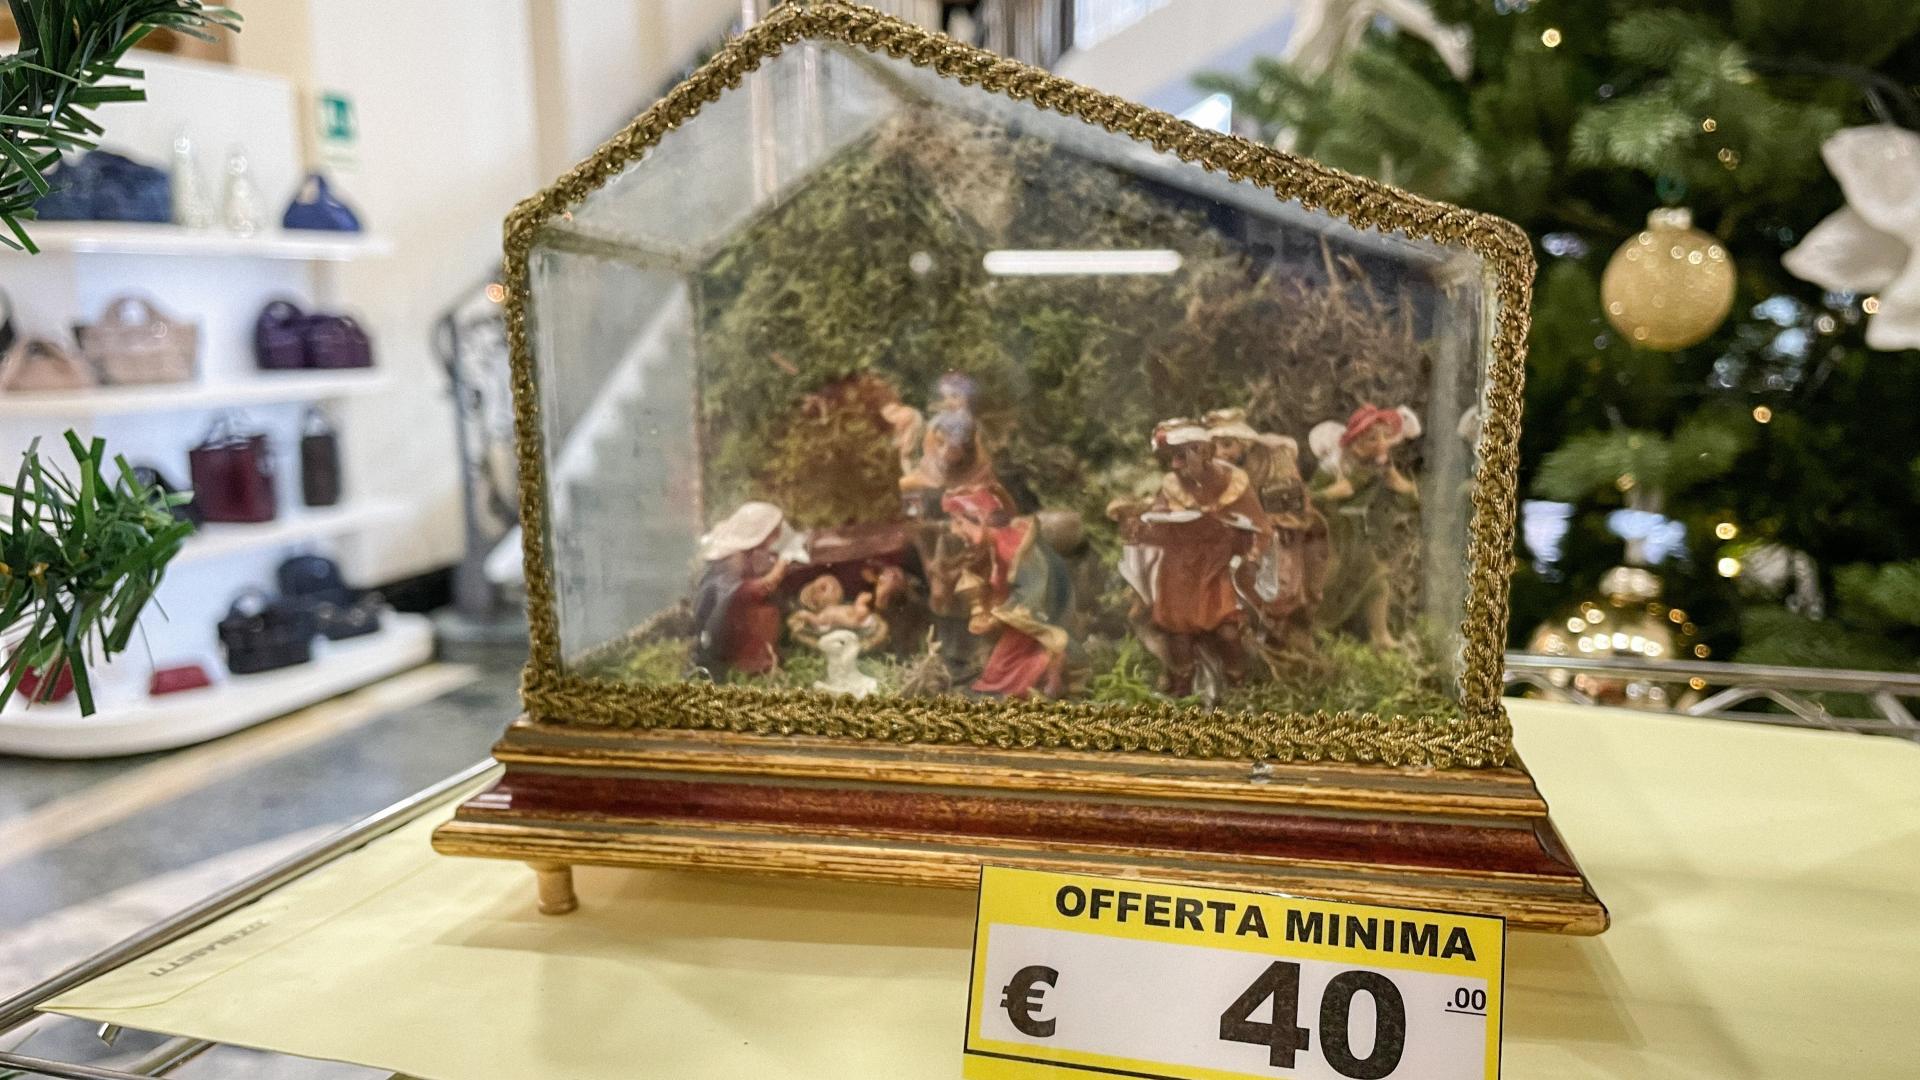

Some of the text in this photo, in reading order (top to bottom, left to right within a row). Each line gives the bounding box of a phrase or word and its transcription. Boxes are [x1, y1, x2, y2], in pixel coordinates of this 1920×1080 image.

[1056, 885, 1476, 961] OFFERTA MINIMA
[1000, 965, 1059, 1037] €
[1220, 960, 1406, 1080] 40
